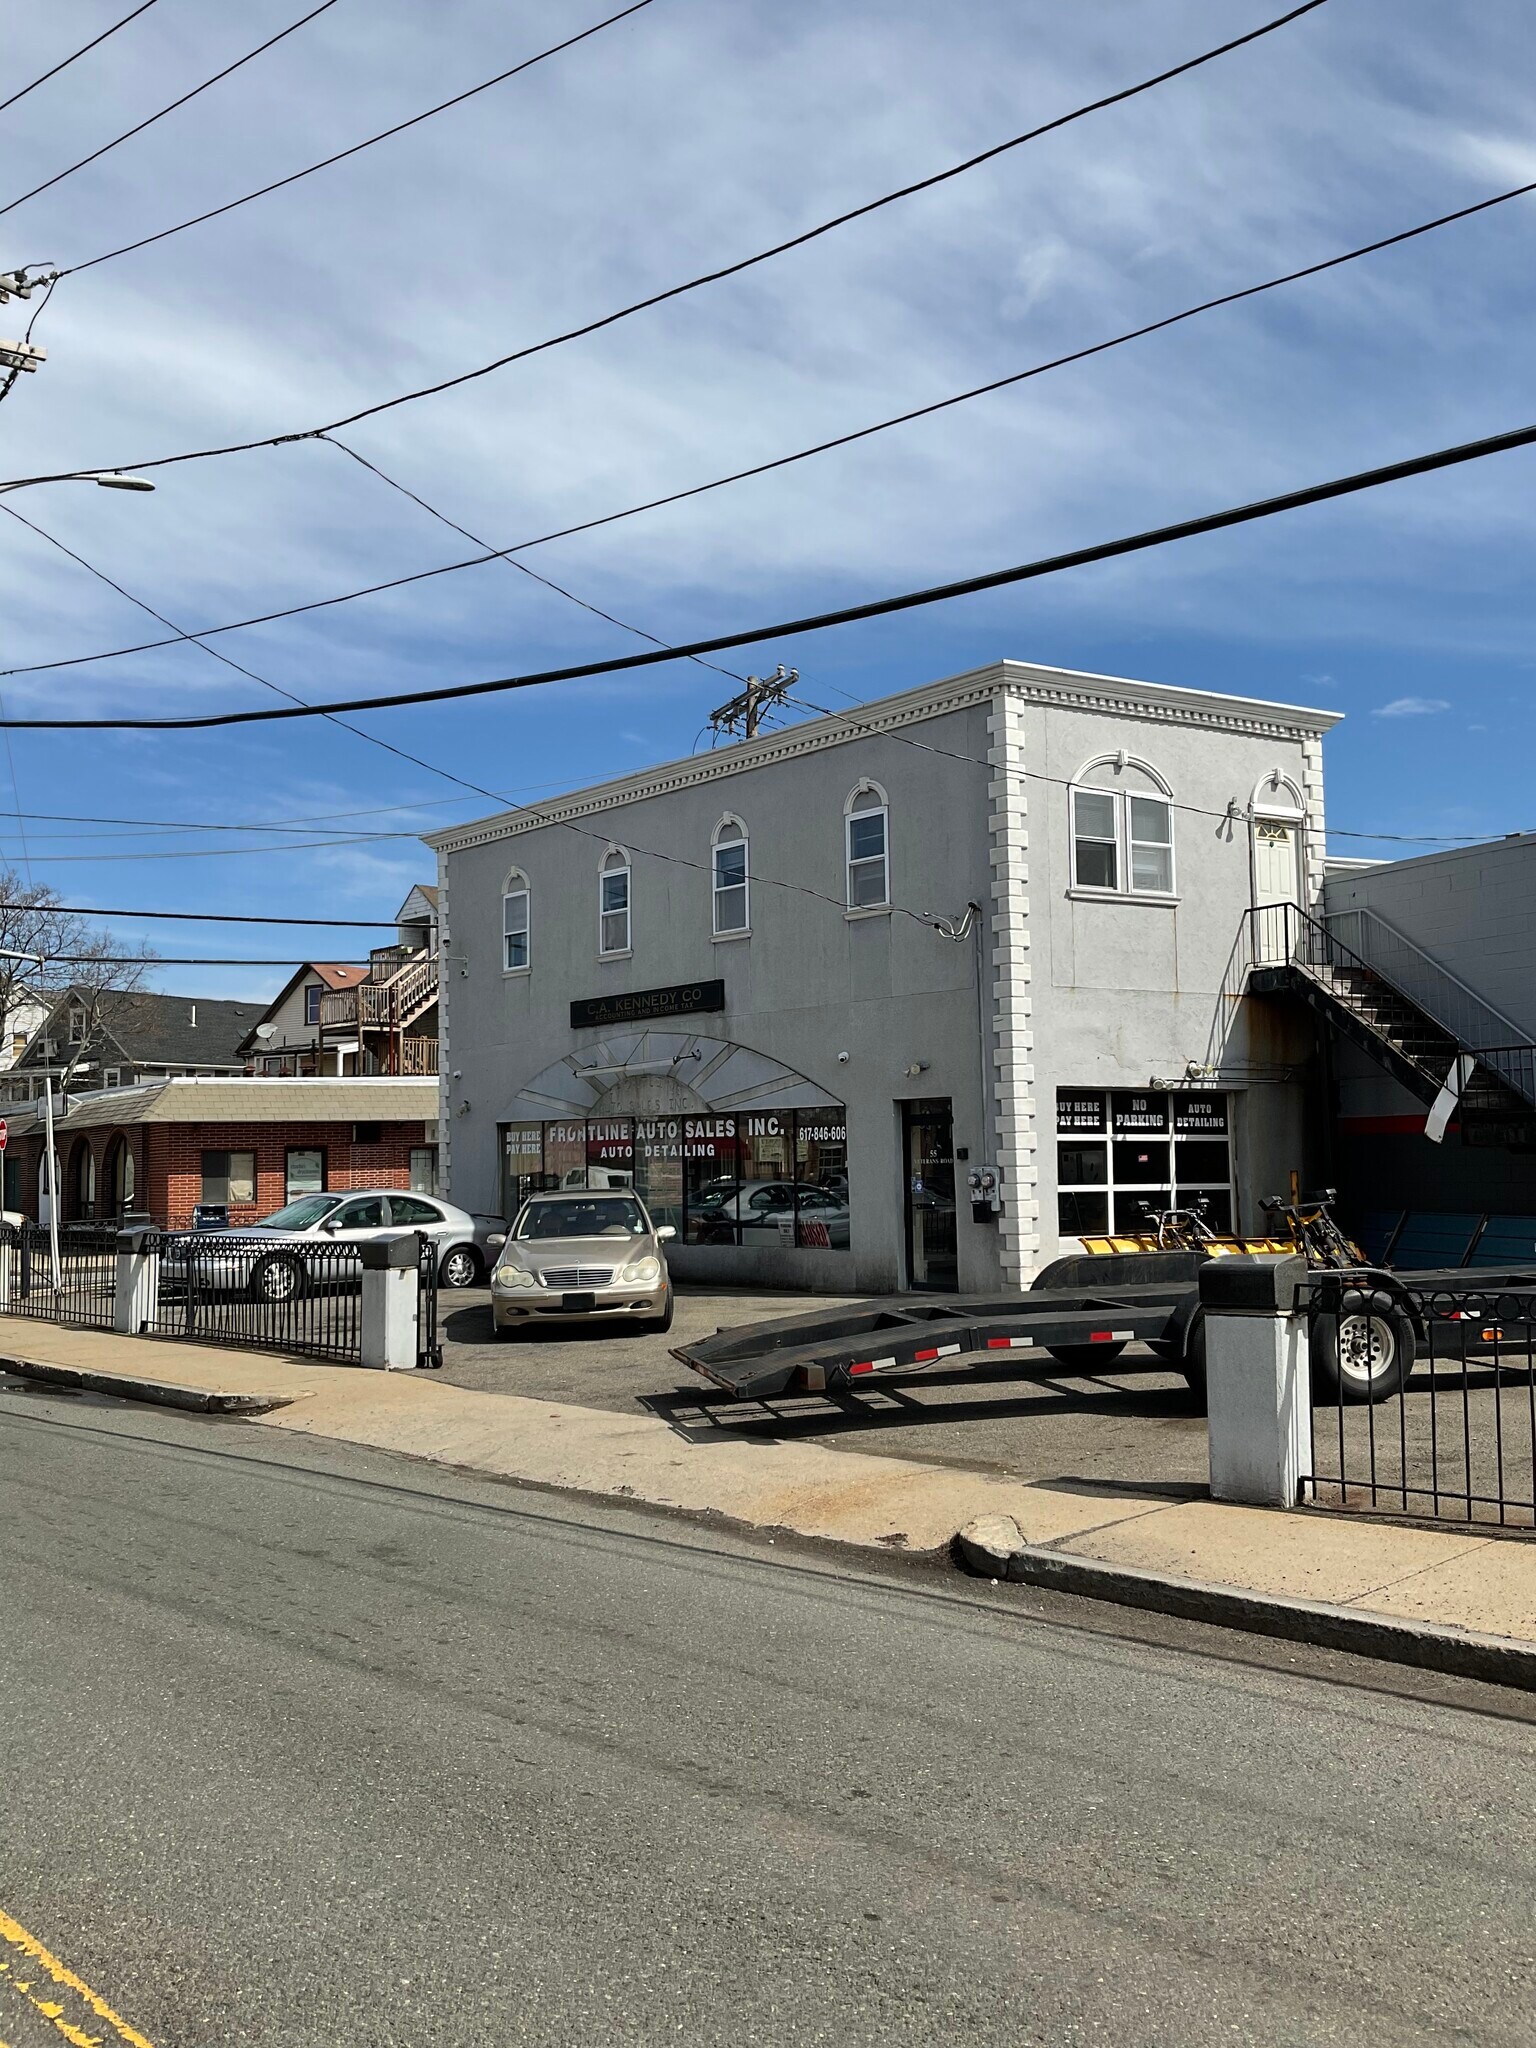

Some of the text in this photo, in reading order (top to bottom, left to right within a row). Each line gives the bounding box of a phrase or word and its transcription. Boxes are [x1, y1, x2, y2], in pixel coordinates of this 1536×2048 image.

[615, 992, 677, 1011] KENNEDY
[682, 989, 702, 1002] CO
[595, 1009, 635, 1021] ACCOUNTING
[637, 1007, 651, 1016] AND
[652, 1004, 678, 1013] INCOME
[1074, 1102, 1100, 1112] HERE
[1132, 1099, 1147, 1111] NO
[1188, 1104, 1212, 1114] AUTO
[1073, 1115, 1100, 1126] HERE
[1116, 1114, 1164, 1126] PARKING
[1176, 1117, 1225, 1127] DETAILING
[506, 1130, 541, 1142] BUY HERE
[549, 1117, 785, 1143] FRONTLINE AUTO SALES INC.
[506, 1143, 541, 1155] PAY HERE
[600, 1144, 715, 1158] AUTO DETAILING
[929, 1149, 938, 1158] 55
